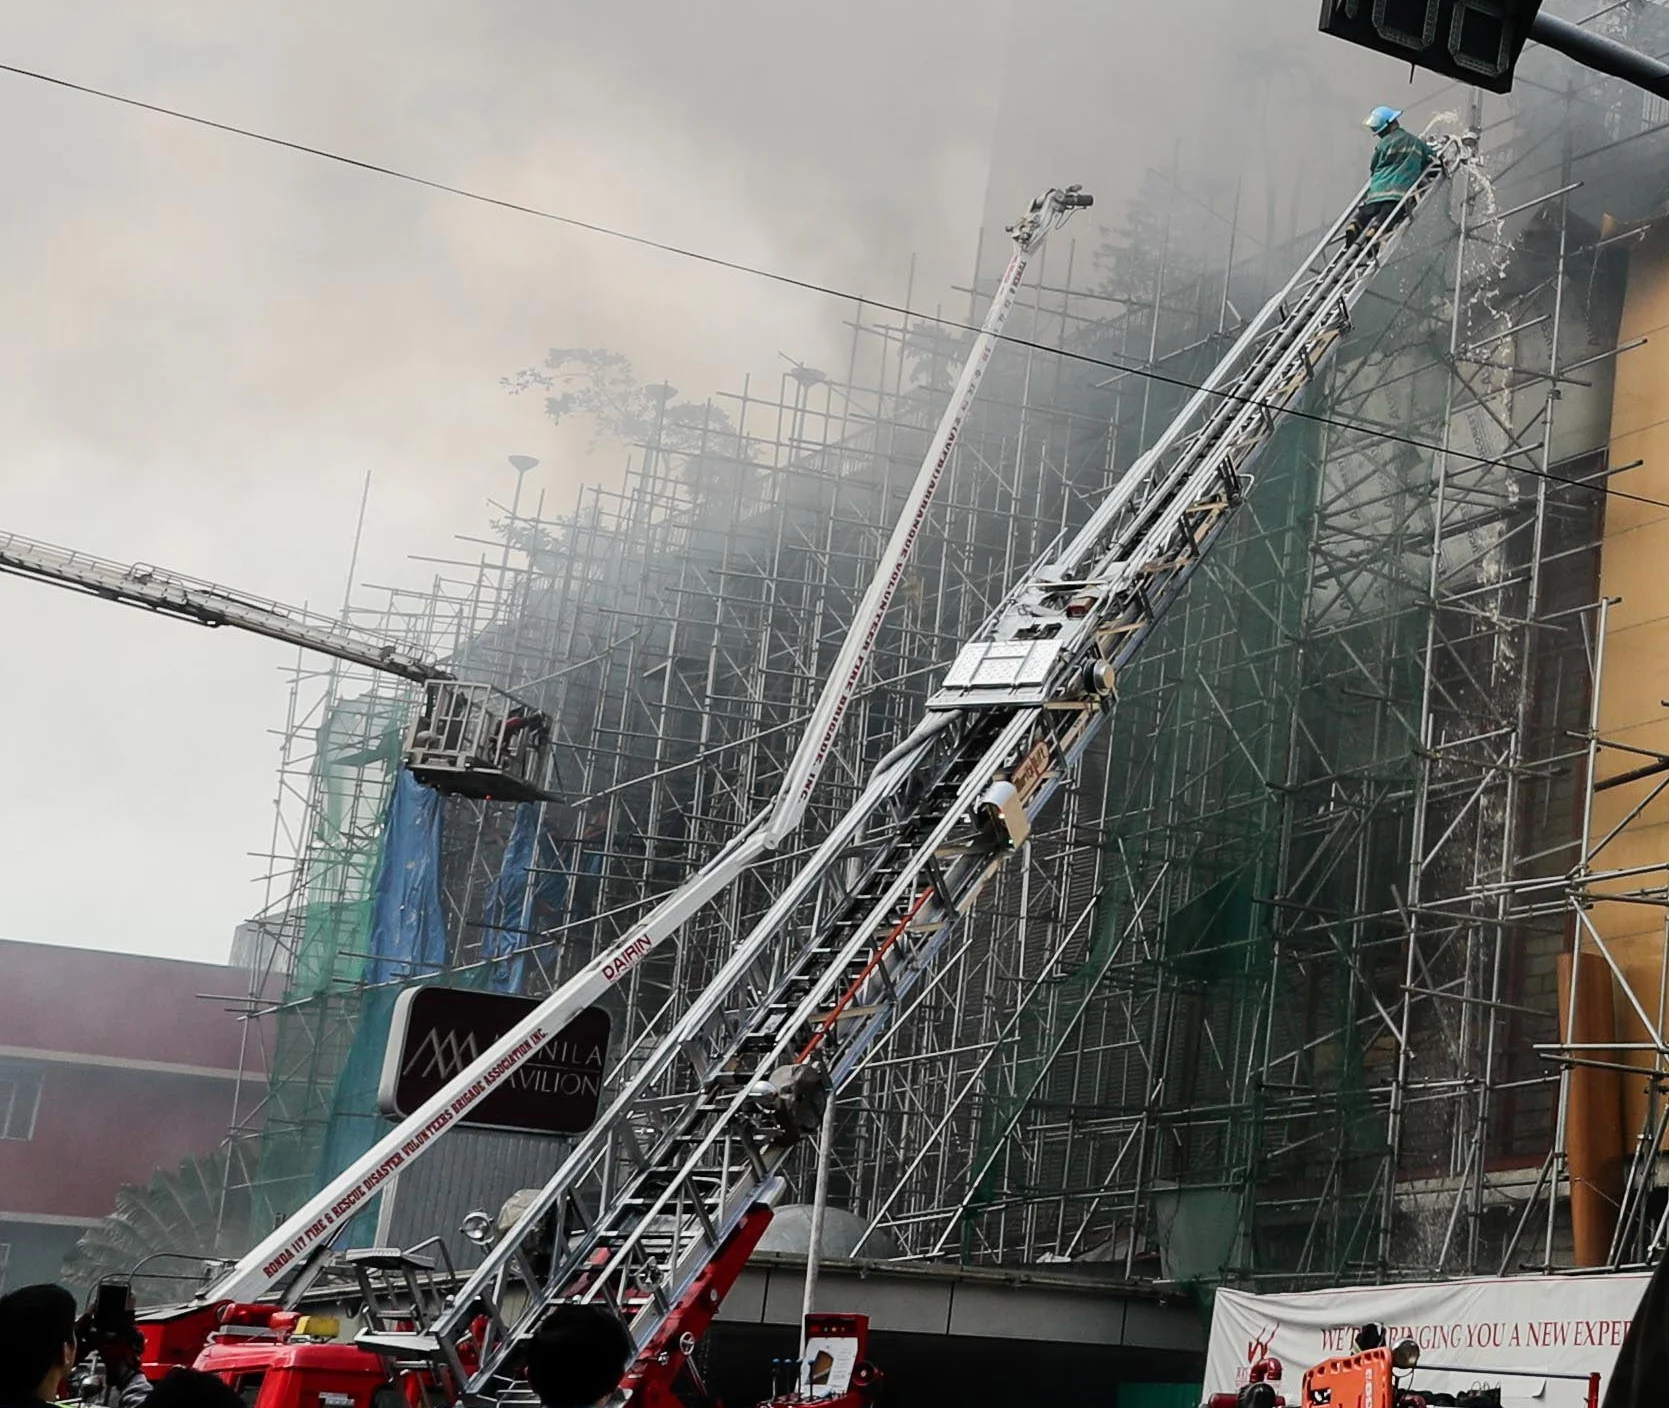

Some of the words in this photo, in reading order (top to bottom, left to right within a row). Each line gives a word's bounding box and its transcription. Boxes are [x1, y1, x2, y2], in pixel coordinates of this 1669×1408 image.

[862, 562, 903, 653] VOLUNTEER
[846, 655, 866, 692] FIRE
[602, 933, 652, 980] DAIRIN
[263, 1248, 294, 1279] RONDA
[304, 1219, 328, 1242] FIRE
[332, 1186, 364, 1218] RESCUE
[363, 1150, 405, 1190] DISASTER
[402, 1109, 453, 1156] VOLUNTEERS
[451, 1081, 486, 1115] BRIGADE
[484, 1041, 533, 1086] ASSOCIATION
[1385, 1324, 1463, 1351] RINGING
[1467, 1323, 1506, 1348] YOU
[1508, 1323, 1521, 1348] A
[1526, 1321, 1572, 1347] NEW
